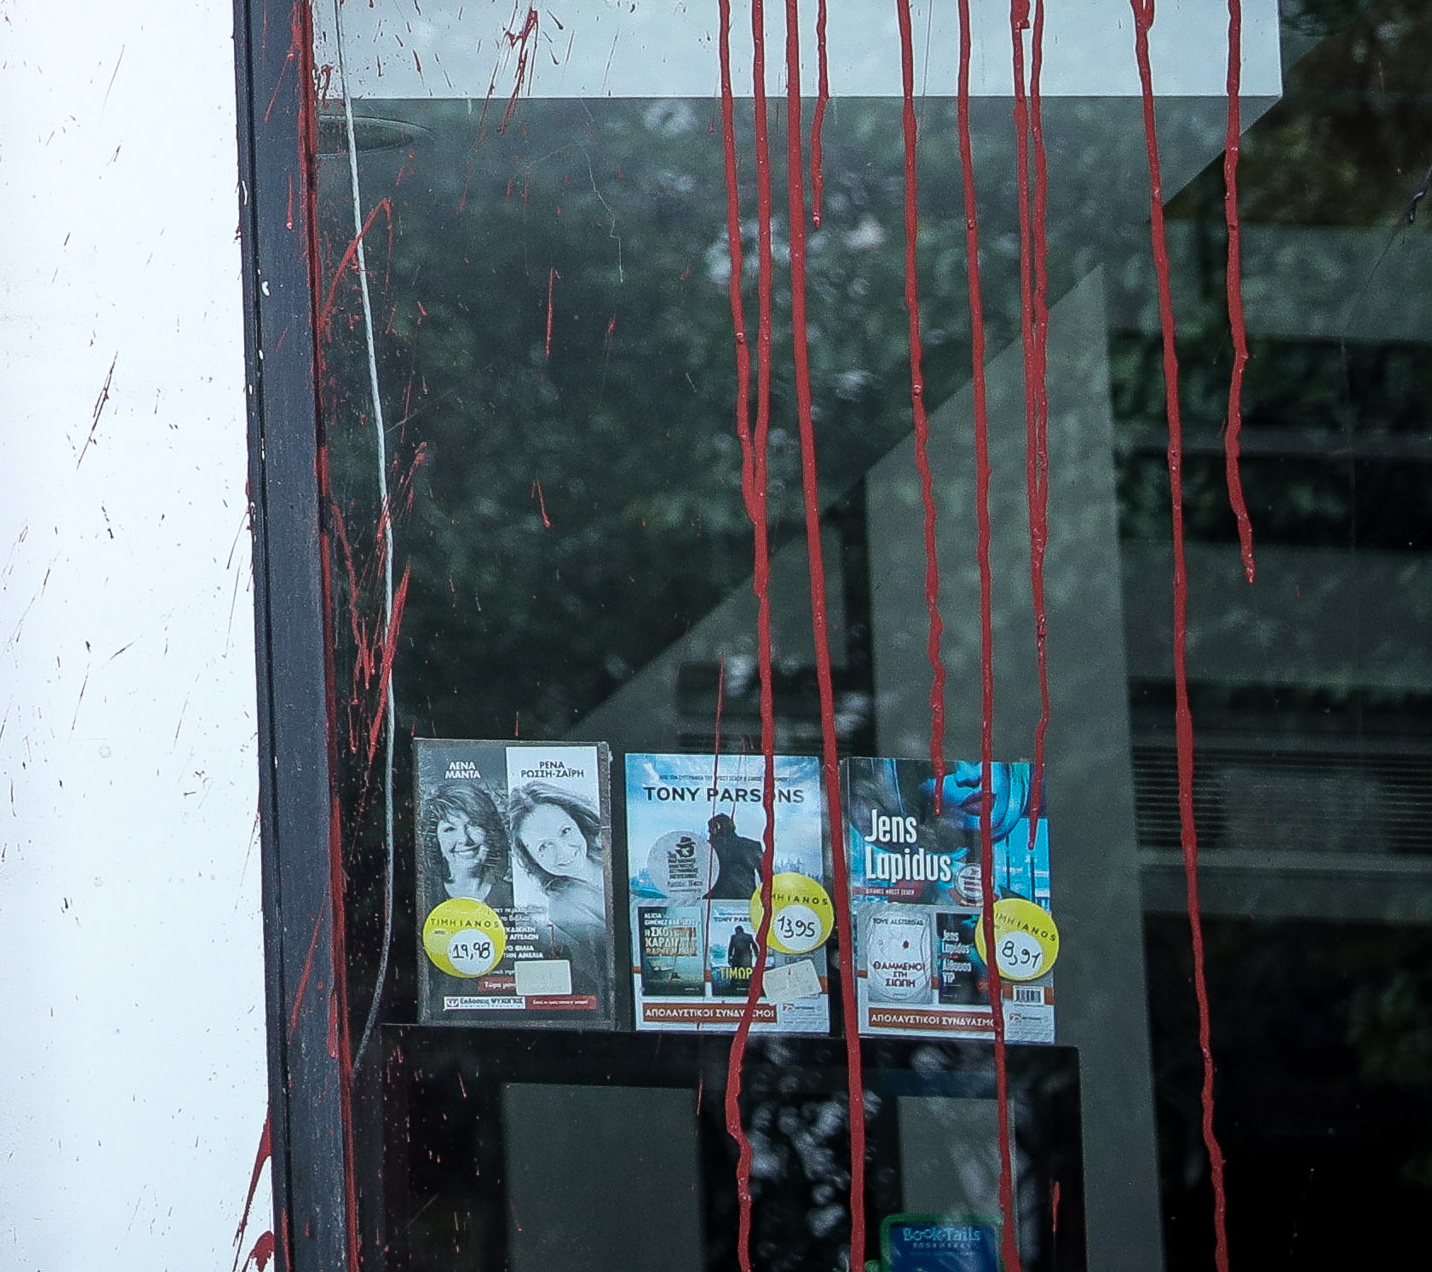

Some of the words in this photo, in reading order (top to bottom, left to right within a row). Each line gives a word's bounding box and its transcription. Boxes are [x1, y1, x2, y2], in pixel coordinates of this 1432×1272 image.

[448, 761, 476, 770] ΛΕΝΑ
[539, 761, 565, 769] ΡΕΝΑ
[444, 770, 481, 779] ΜΑΝΤΑ
[643, 787, 700, 802] TONY
[706, 788, 806, 803] PARSNS
[864, 809, 917, 843] Jens
[865, 846, 952, 883] Lapidus
[873, 961, 925, 971] ΘΑΜΜΕΝΟΙ
[645, 1008, 714, 1017] ΑΠΟΛΑΥΣΤΙΚΟΙ
[716, 1009, 774, 1018] ΣΥΝΔΥΣΜΟΙ
[871, 1014, 940, 1025] ΑΠΟΛΑΥΣΤΙΚΟΙ
